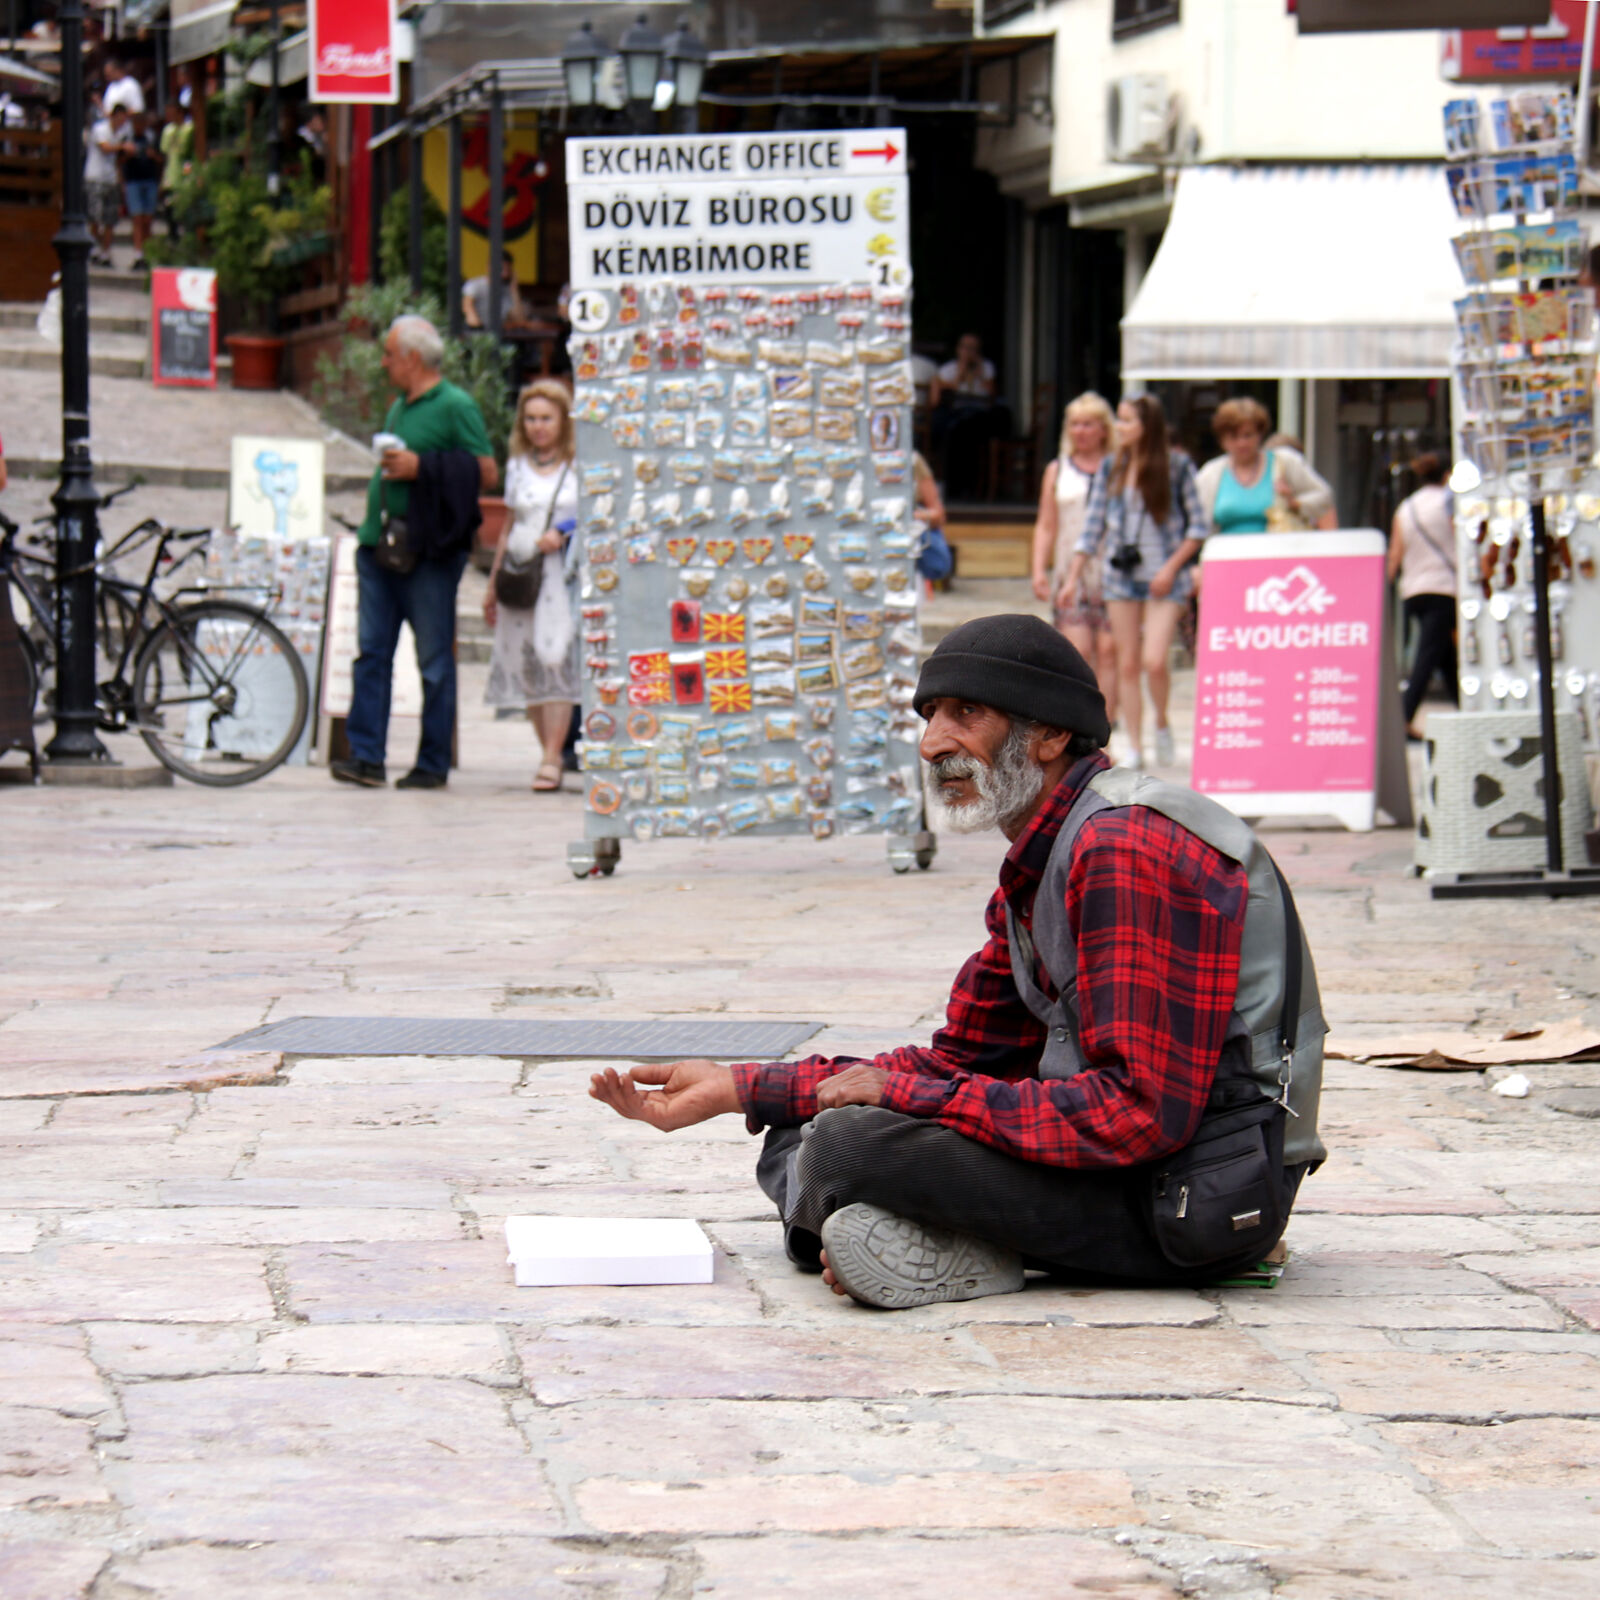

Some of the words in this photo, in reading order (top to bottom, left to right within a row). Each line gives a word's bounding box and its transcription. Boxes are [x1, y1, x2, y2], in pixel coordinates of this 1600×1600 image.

[582, 145, 731, 173] EXCHANGE
[747, 141, 840, 170] OFFICE
[708, 189, 854, 226] BÜROSU
[1209, 622, 1368, 650] E-VOUCHER
